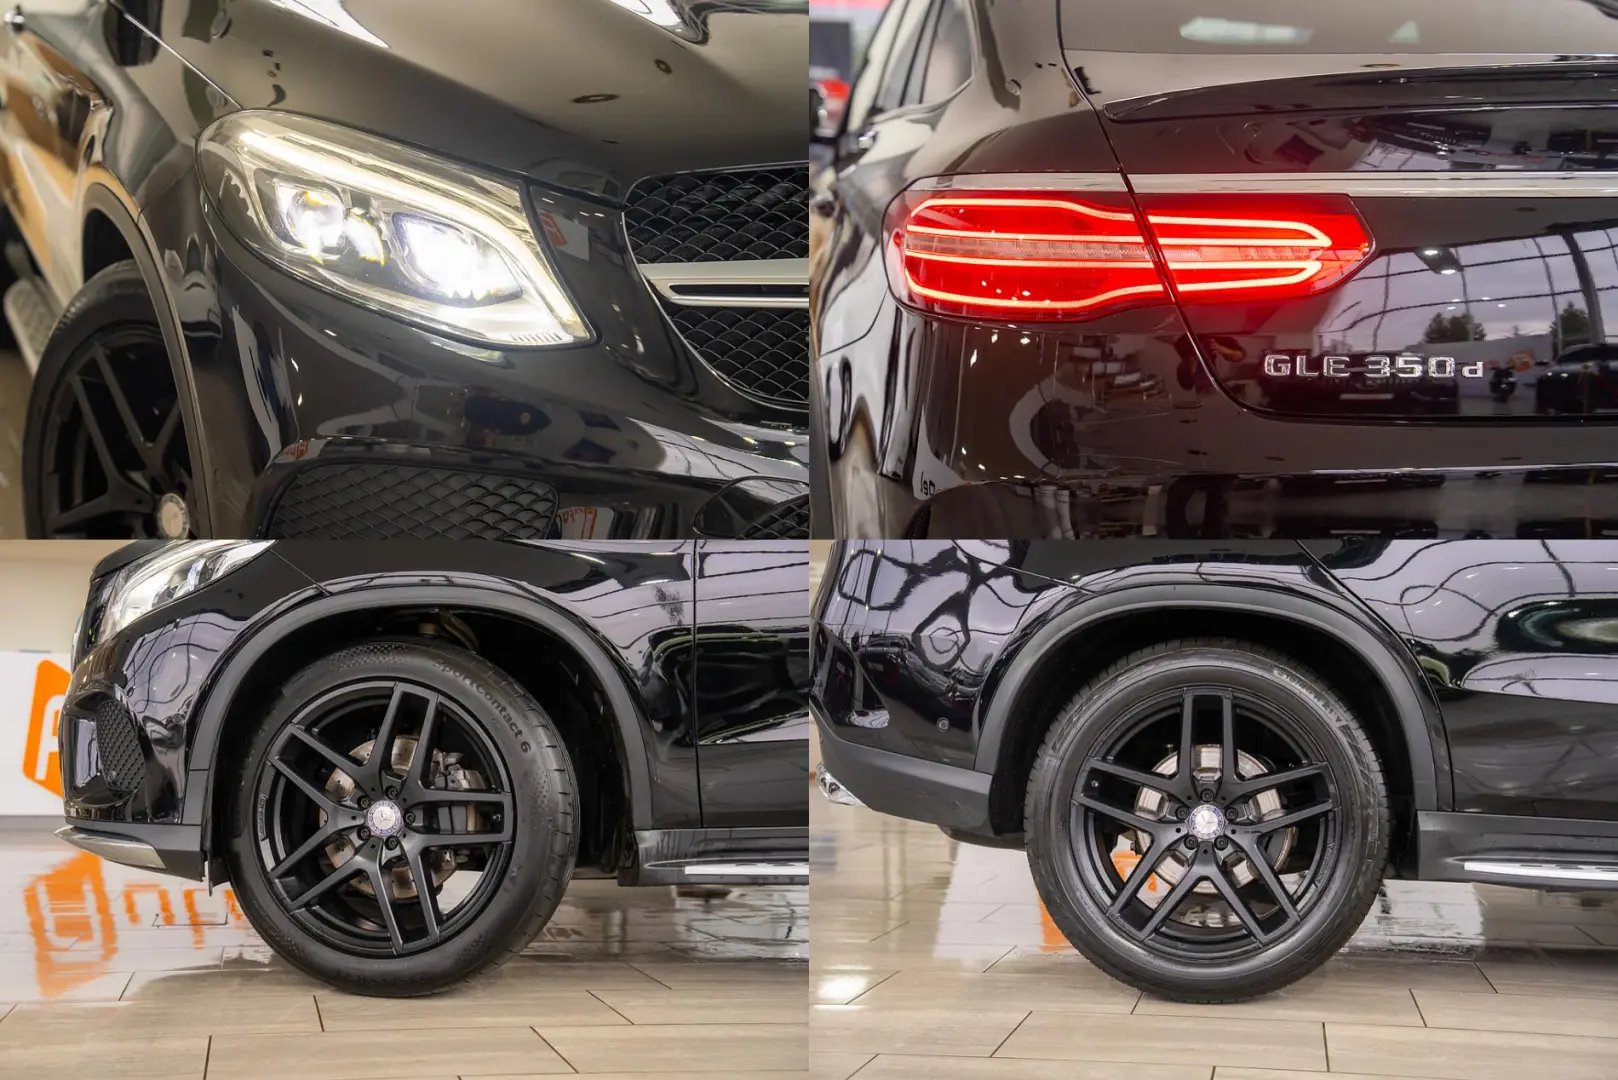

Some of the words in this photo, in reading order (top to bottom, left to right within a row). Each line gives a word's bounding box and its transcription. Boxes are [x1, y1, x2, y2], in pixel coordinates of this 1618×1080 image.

[1264, 354, 1350, 377] GLE
[432, 659, 523, 739] SportContact
[520, 740, 532, 754] 6
